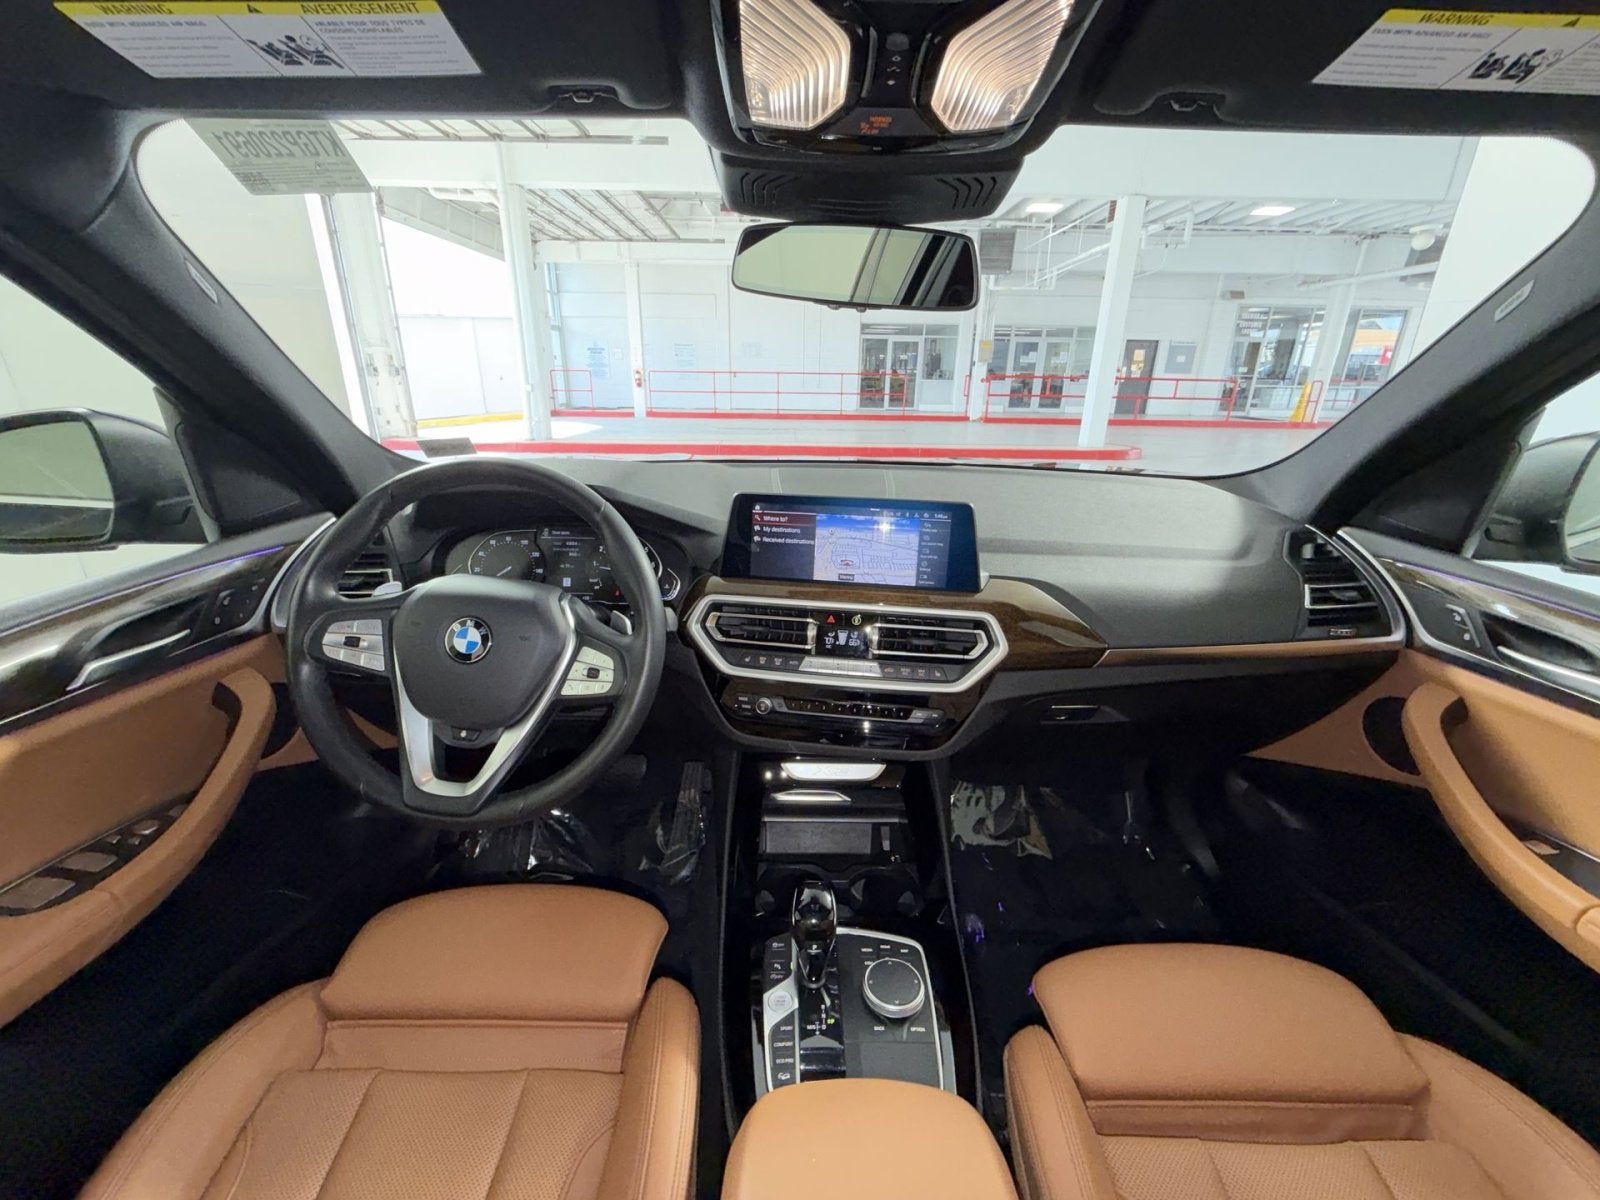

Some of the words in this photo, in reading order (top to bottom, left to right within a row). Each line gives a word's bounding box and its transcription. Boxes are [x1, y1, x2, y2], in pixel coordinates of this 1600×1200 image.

[94, 3, 174, 15] WARNING
[301, 1, 420, 15] AVERTISSEMENT
[1418, 12, 1494, 25] WARNING
[771, 526, 801, 534] destinations
[452, 619, 488, 636] BMW
